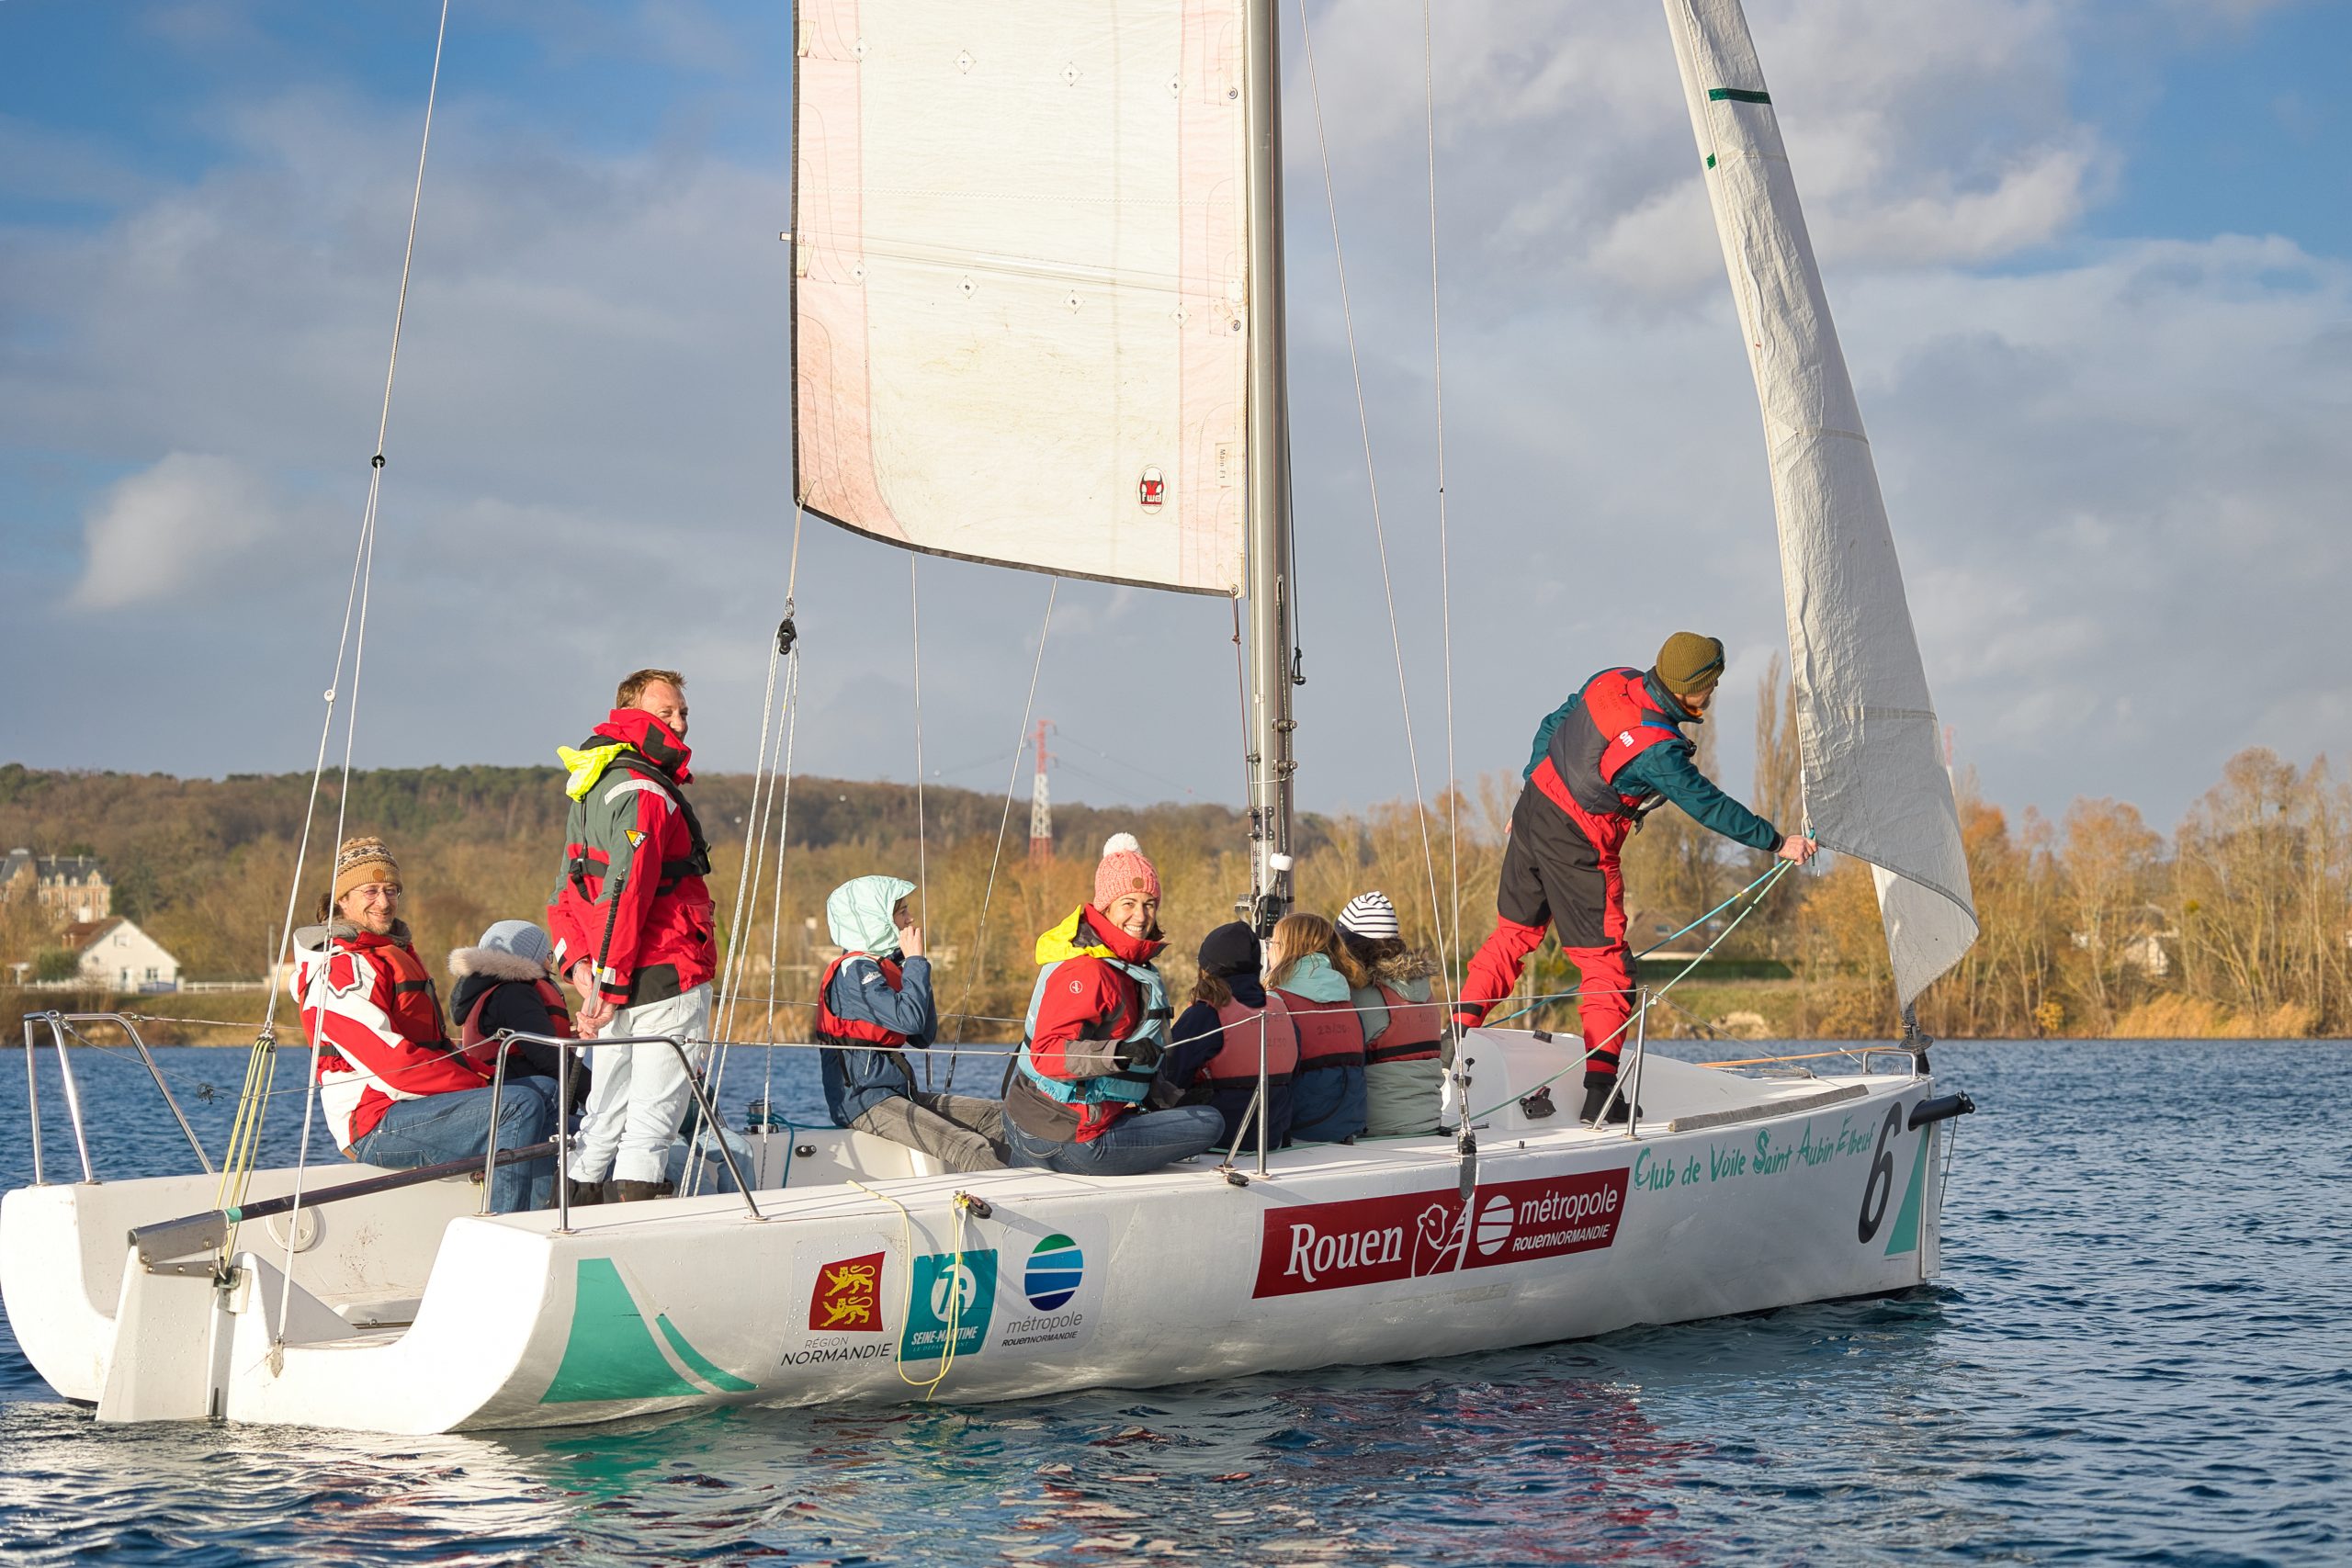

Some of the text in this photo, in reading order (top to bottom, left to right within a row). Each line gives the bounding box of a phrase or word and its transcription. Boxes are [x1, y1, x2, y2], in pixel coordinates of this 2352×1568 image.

[1634, 1146, 1676, 1192] Club
[1680, 1155, 1702, 1187] de
[1710, 1142, 1747, 1182] Voile
[1752, 1127, 1793, 1175] Saint
[1795, 1117, 1835, 1167] Aubin
[1857, 1101, 1903, 1244] 6
[1519, 1183, 1618, 1225] métropole
[1283, 1223, 1404, 1283] Rouen
[910, 1325, 979, 1346] SEINE-MARTIME
[1006, 1311, 1082, 1334] métropole
[780, 1342, 893, 1367] NORMANDIE
[804, 1336, 849, 1349] RÉGION
